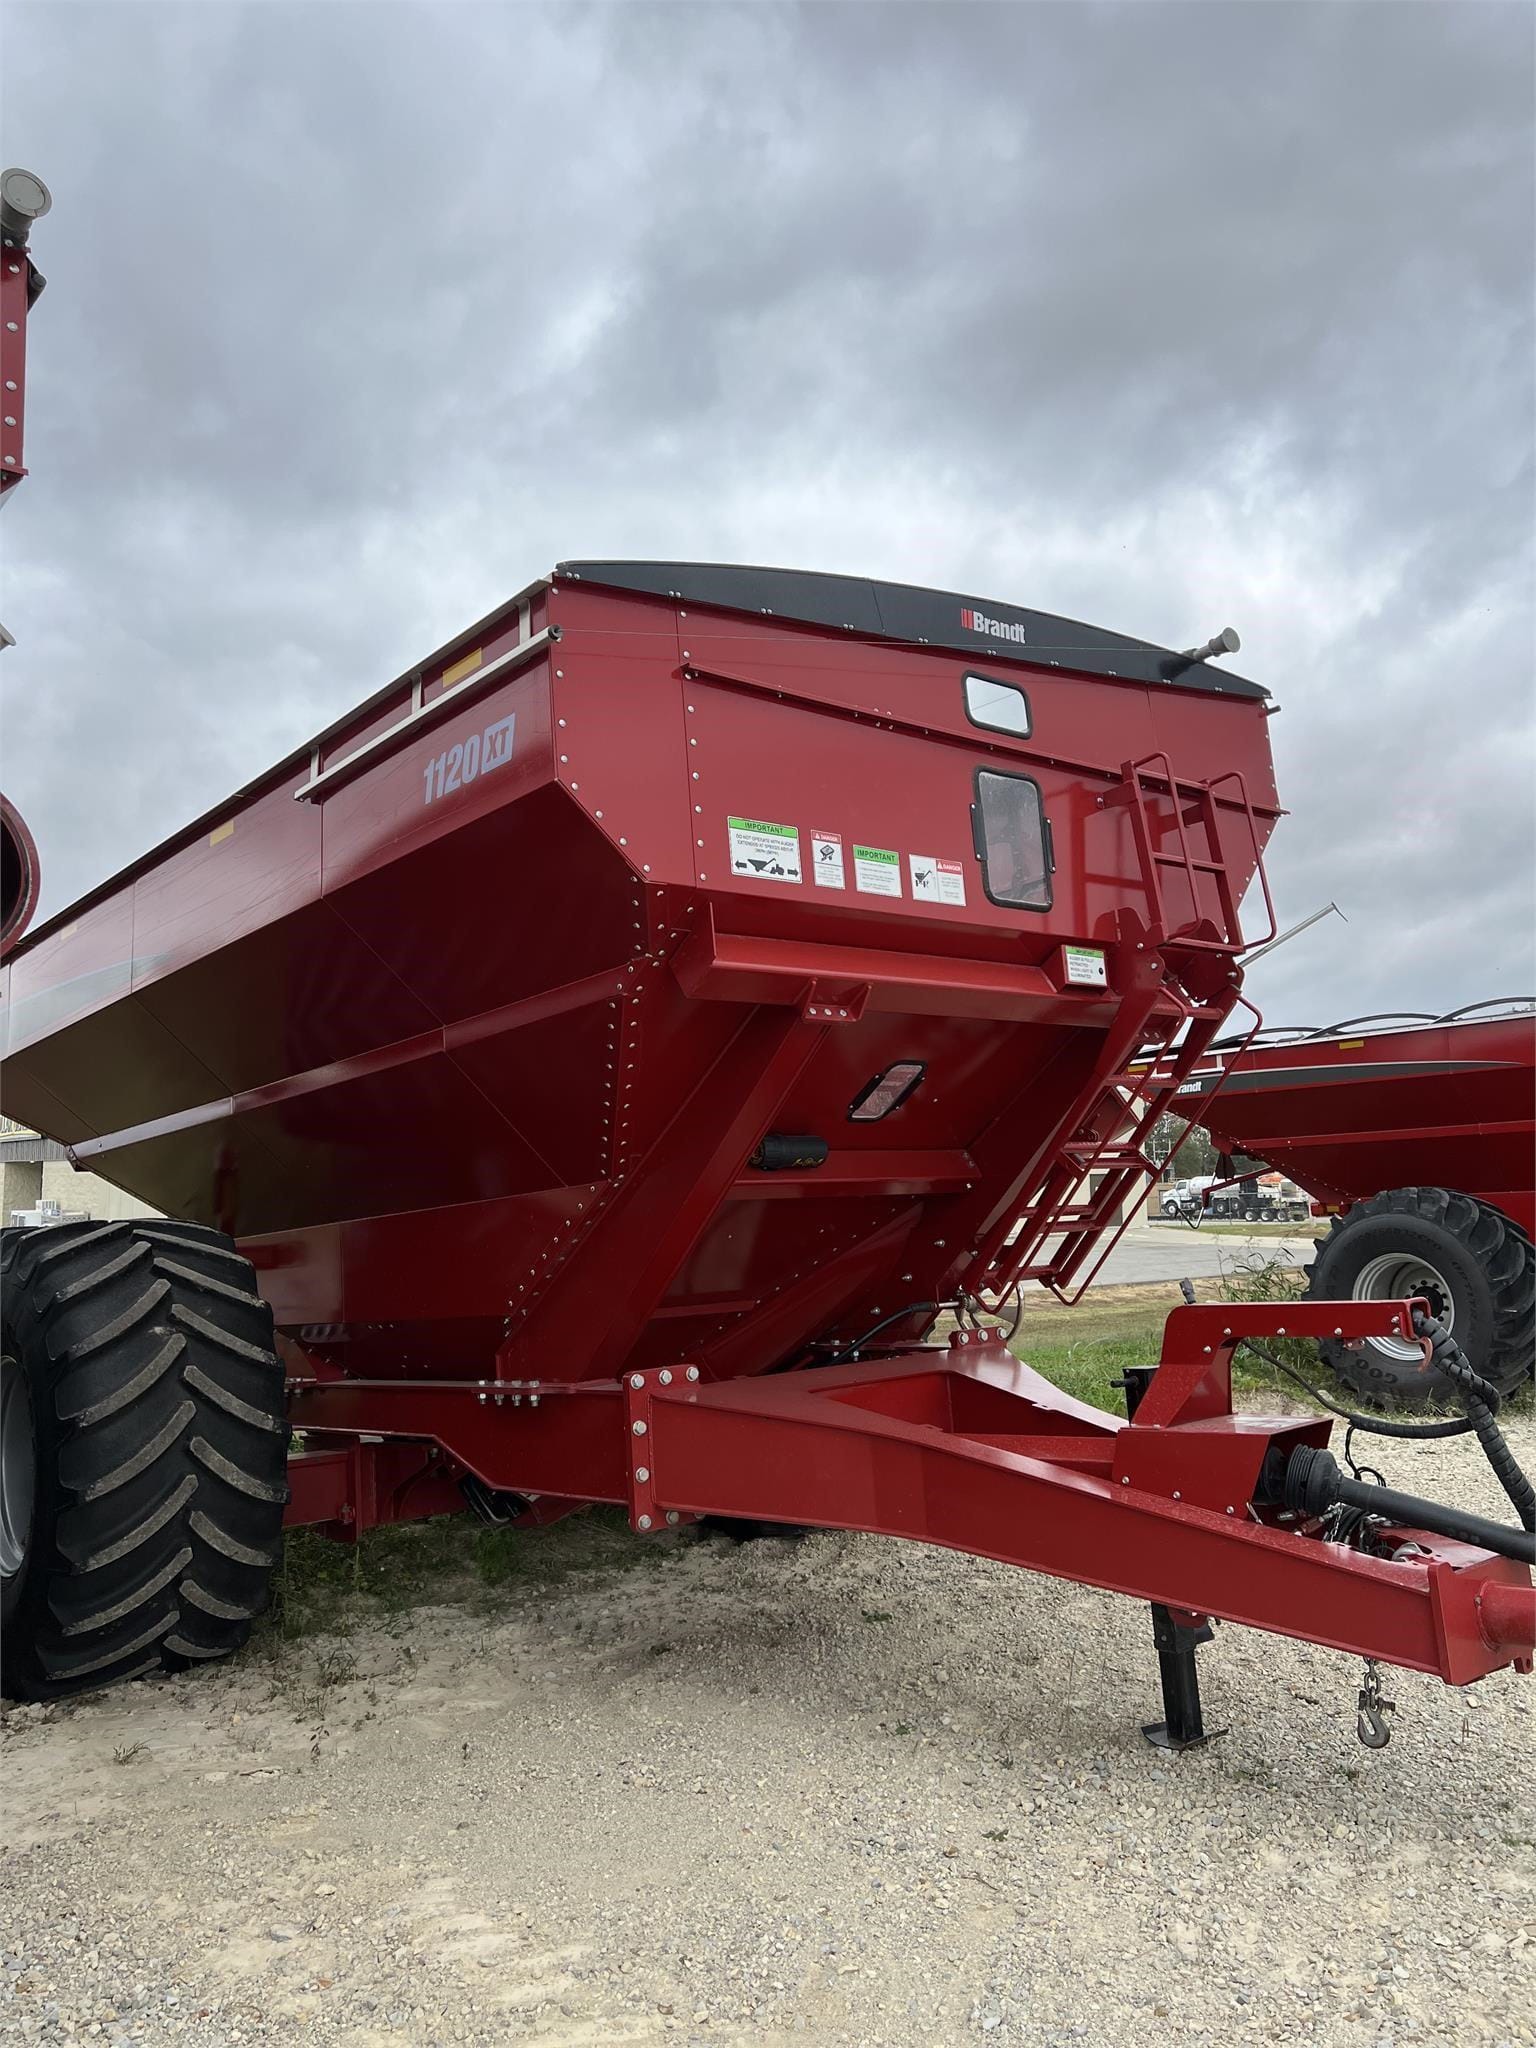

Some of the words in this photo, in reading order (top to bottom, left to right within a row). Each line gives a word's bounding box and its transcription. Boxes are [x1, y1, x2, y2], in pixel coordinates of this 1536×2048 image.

[973, 610, 1026, 644] Brandt
[423, 734, 480, 805] 1120
[744, 822, 783, 834] IMPORTANT
[857, 849, 895, 862] IMPORTANT
[942, 863, 961, 871] DANGER
[1176, 1080, 1202, 1094] randt
